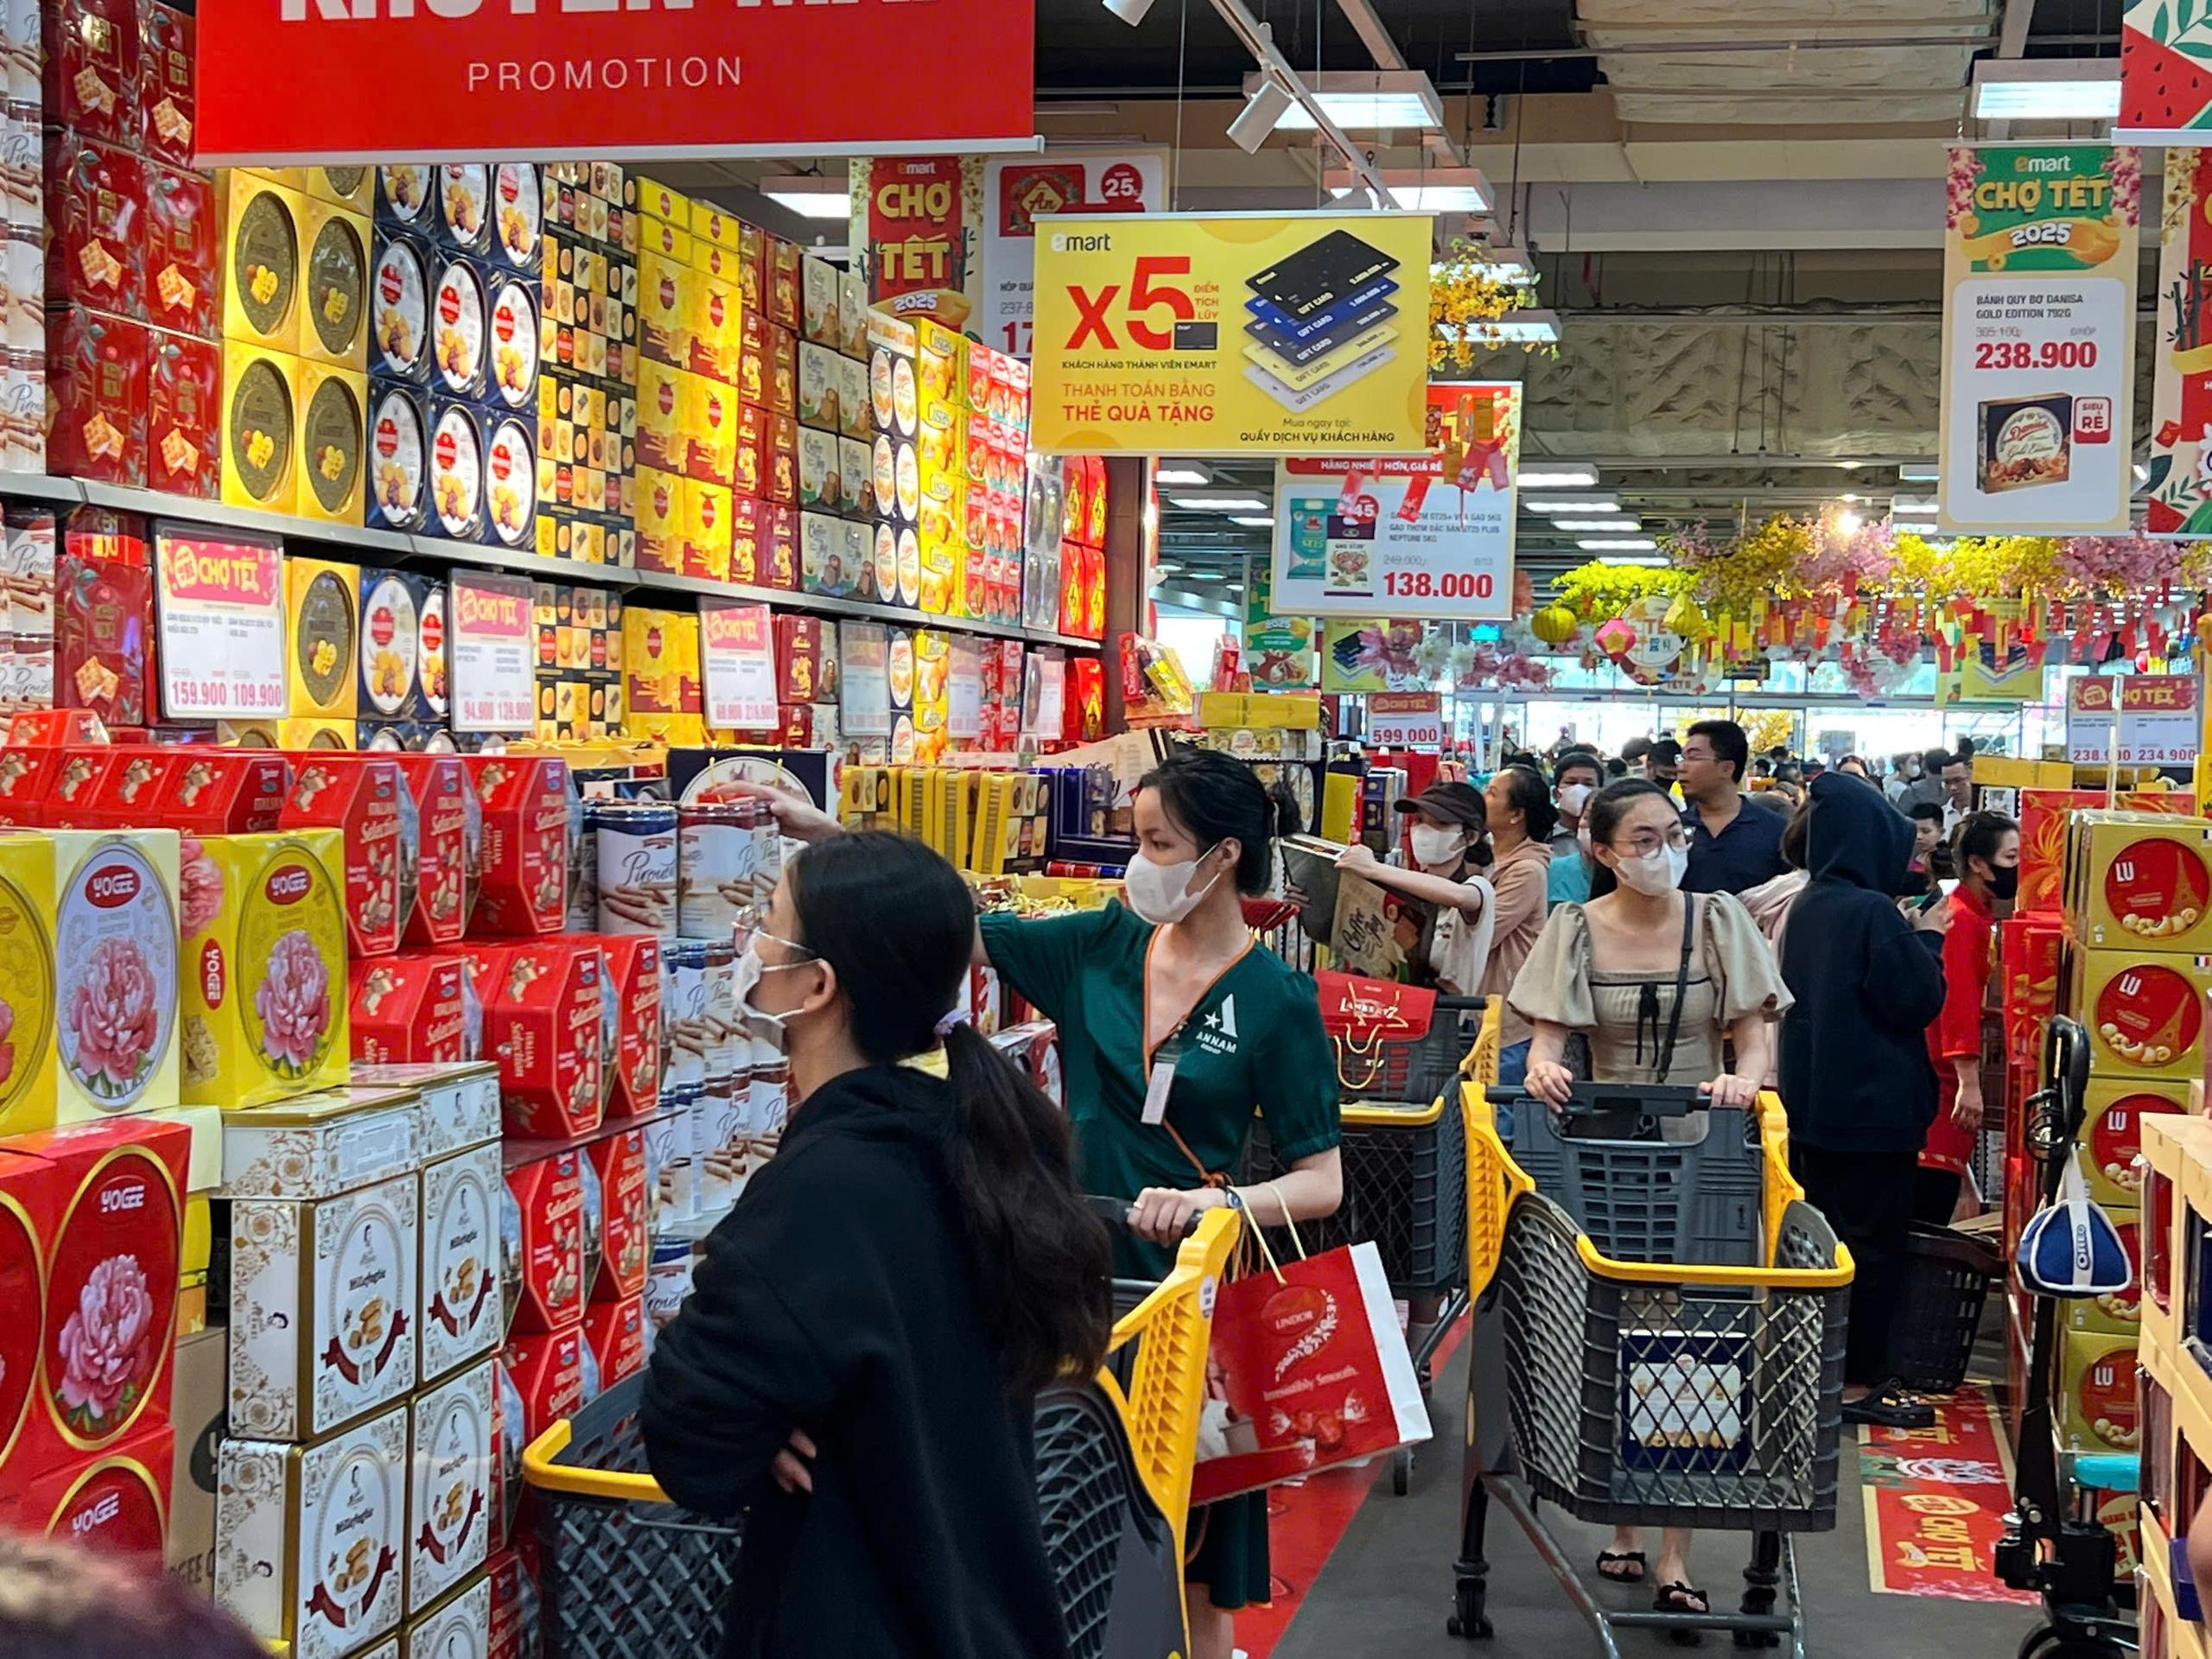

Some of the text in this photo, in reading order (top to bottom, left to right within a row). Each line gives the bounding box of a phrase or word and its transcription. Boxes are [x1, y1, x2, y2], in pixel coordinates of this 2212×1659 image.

[467, 55, 741, 92] PROMOTION
[2015, 155, 2071, 172] emart
[876, 180, 952, 223] CHỢ
[1974, 174, 2112, 213] CHỢ TẾT
[1051, 233, 1111, 251] emart
[2010, 222, 2073, 246] 2025
[878, 232, 952, 281] TẾT
[894, 292, 938, 312] 2025
[2006, 295, 2026, 305] QUY
[1976, 308, 2002, 320] GOLD
[2005, 308, 2044, 320] EDITION
[1062, 359, 1217, 370] KHÁCH HÀNG THÀNH VIÊN EMART
[1975, 341, 2097, 370] 238.900
[1063, 384, 1116, 397] THANH
[1122, 379, 1166, 397] TOÁN
[1062, 400, 1215, 426] THẺ QUÀ TẶNG
[1283, 417, 1305, 428] Mua
[1306, 420, 1333, 430] ngay
[1273, 432, 1301, 444] DỊCH
[1302, 432, 1319, 444] VỤ
[1320, 430, 1361, 442] KHÁCH
[1363, 430, 1395, 442] HÀNG
[1320, 460, 1350, 471] HÀNG
[1351, 458, 1382, 471] NHIỀ
[1383, 571, 1493, 598] 138.000
[172, 680, 282, 708] 159.900 109.900
[1373, 728, 1437, 743] 599.000
[2138, 749, 2196, 761] 234.900
[2115, 861, 2134, 882] LU
[206, 948, 221, 1001] YOGEE
[2119, 973, 2142, 996] LU
[1196, 1031, 1236, 1053] ANNAM
[2107, 1111, 2127, 1131] LU
[100, 1185, 145, 1213] YOGEE
[2075, 1223, 2092, 1271] OREO
[2094, 1367, 2113, 1386] LU
[72, 1492, 119, 1537] YOGEE
